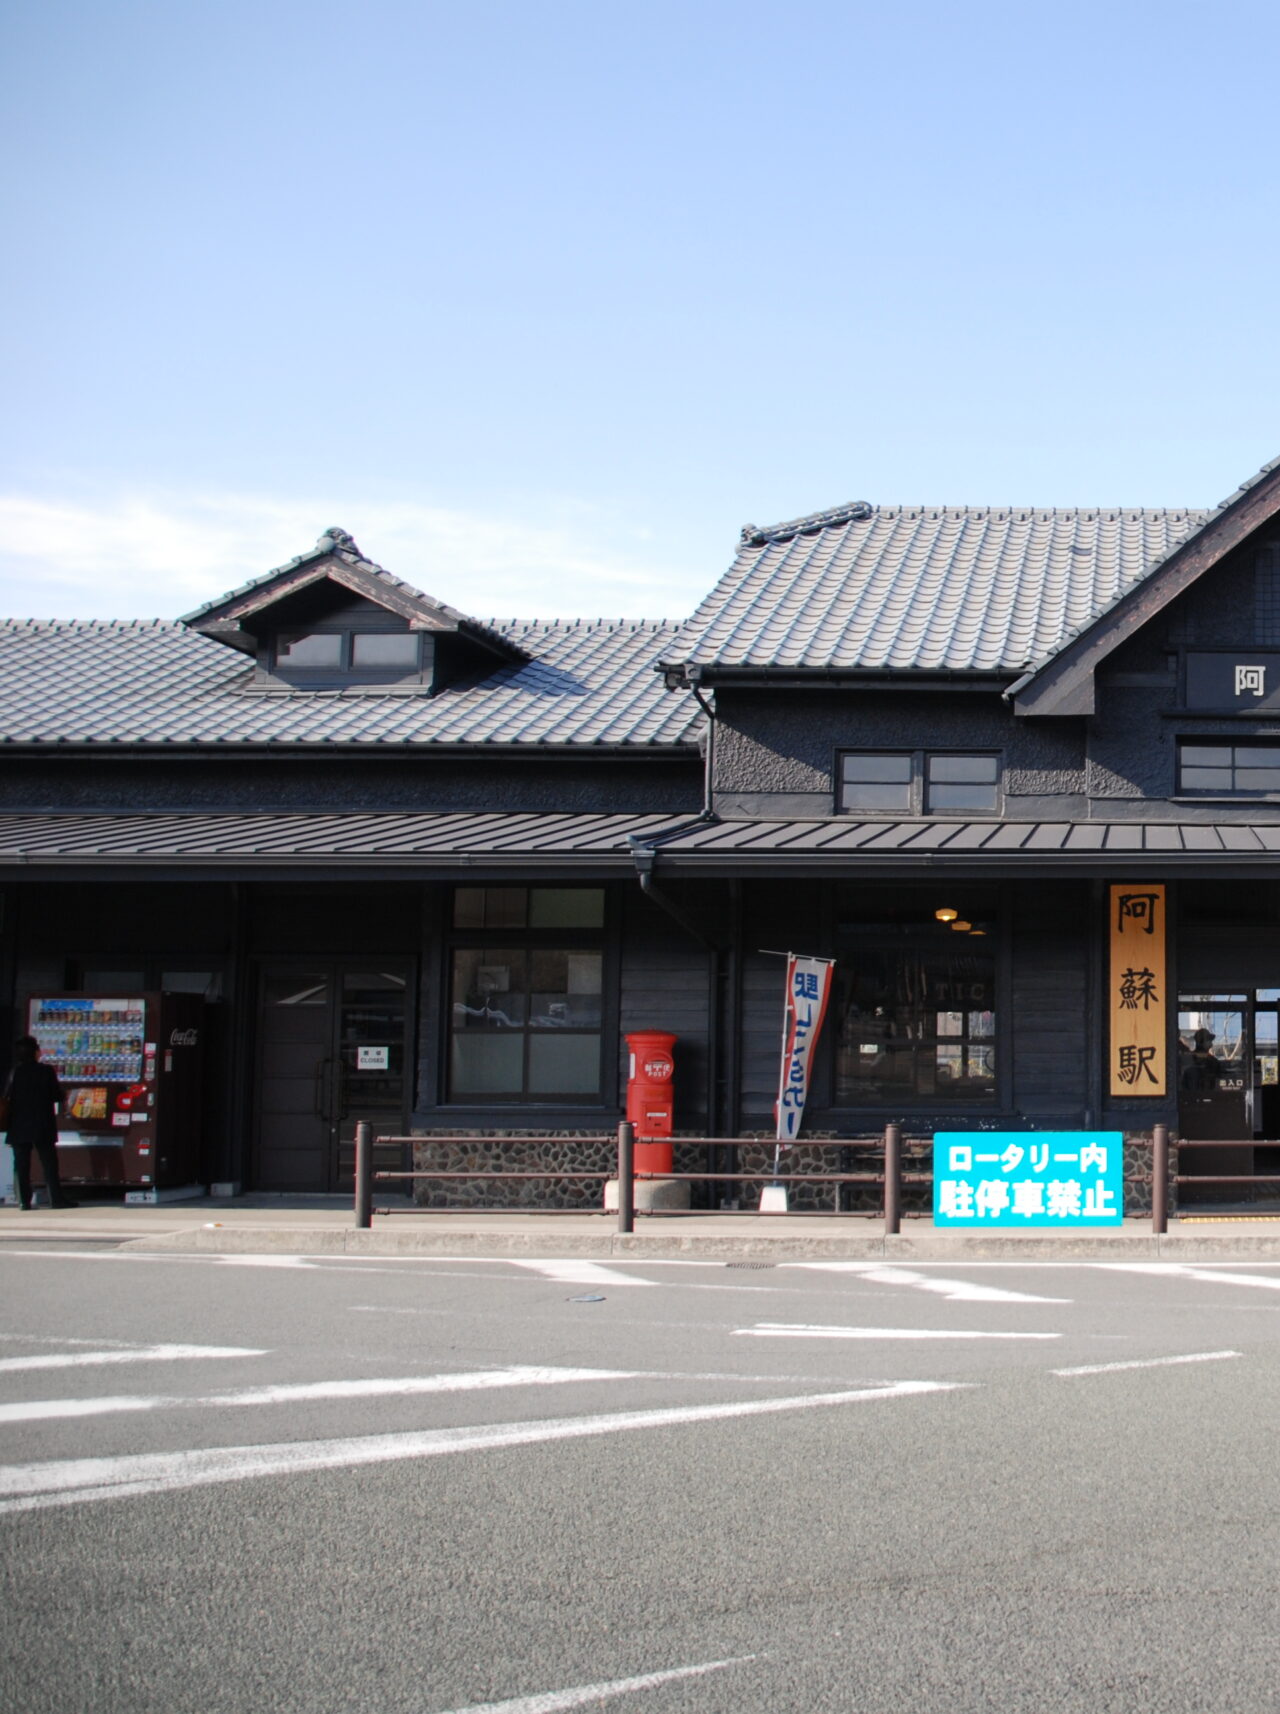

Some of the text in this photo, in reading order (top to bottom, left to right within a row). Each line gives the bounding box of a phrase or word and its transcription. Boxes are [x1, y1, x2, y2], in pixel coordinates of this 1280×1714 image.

[935, 983, 986, 1001] TIC
[1117, 893, 1160, 1085] 阿蘇駅
[1219, 1079, 1244, 1087] 出入口
[948, 1142, 1108, 1173] ロータリー内
[938, 1178, 1117, 1219] 駐停車禁止
